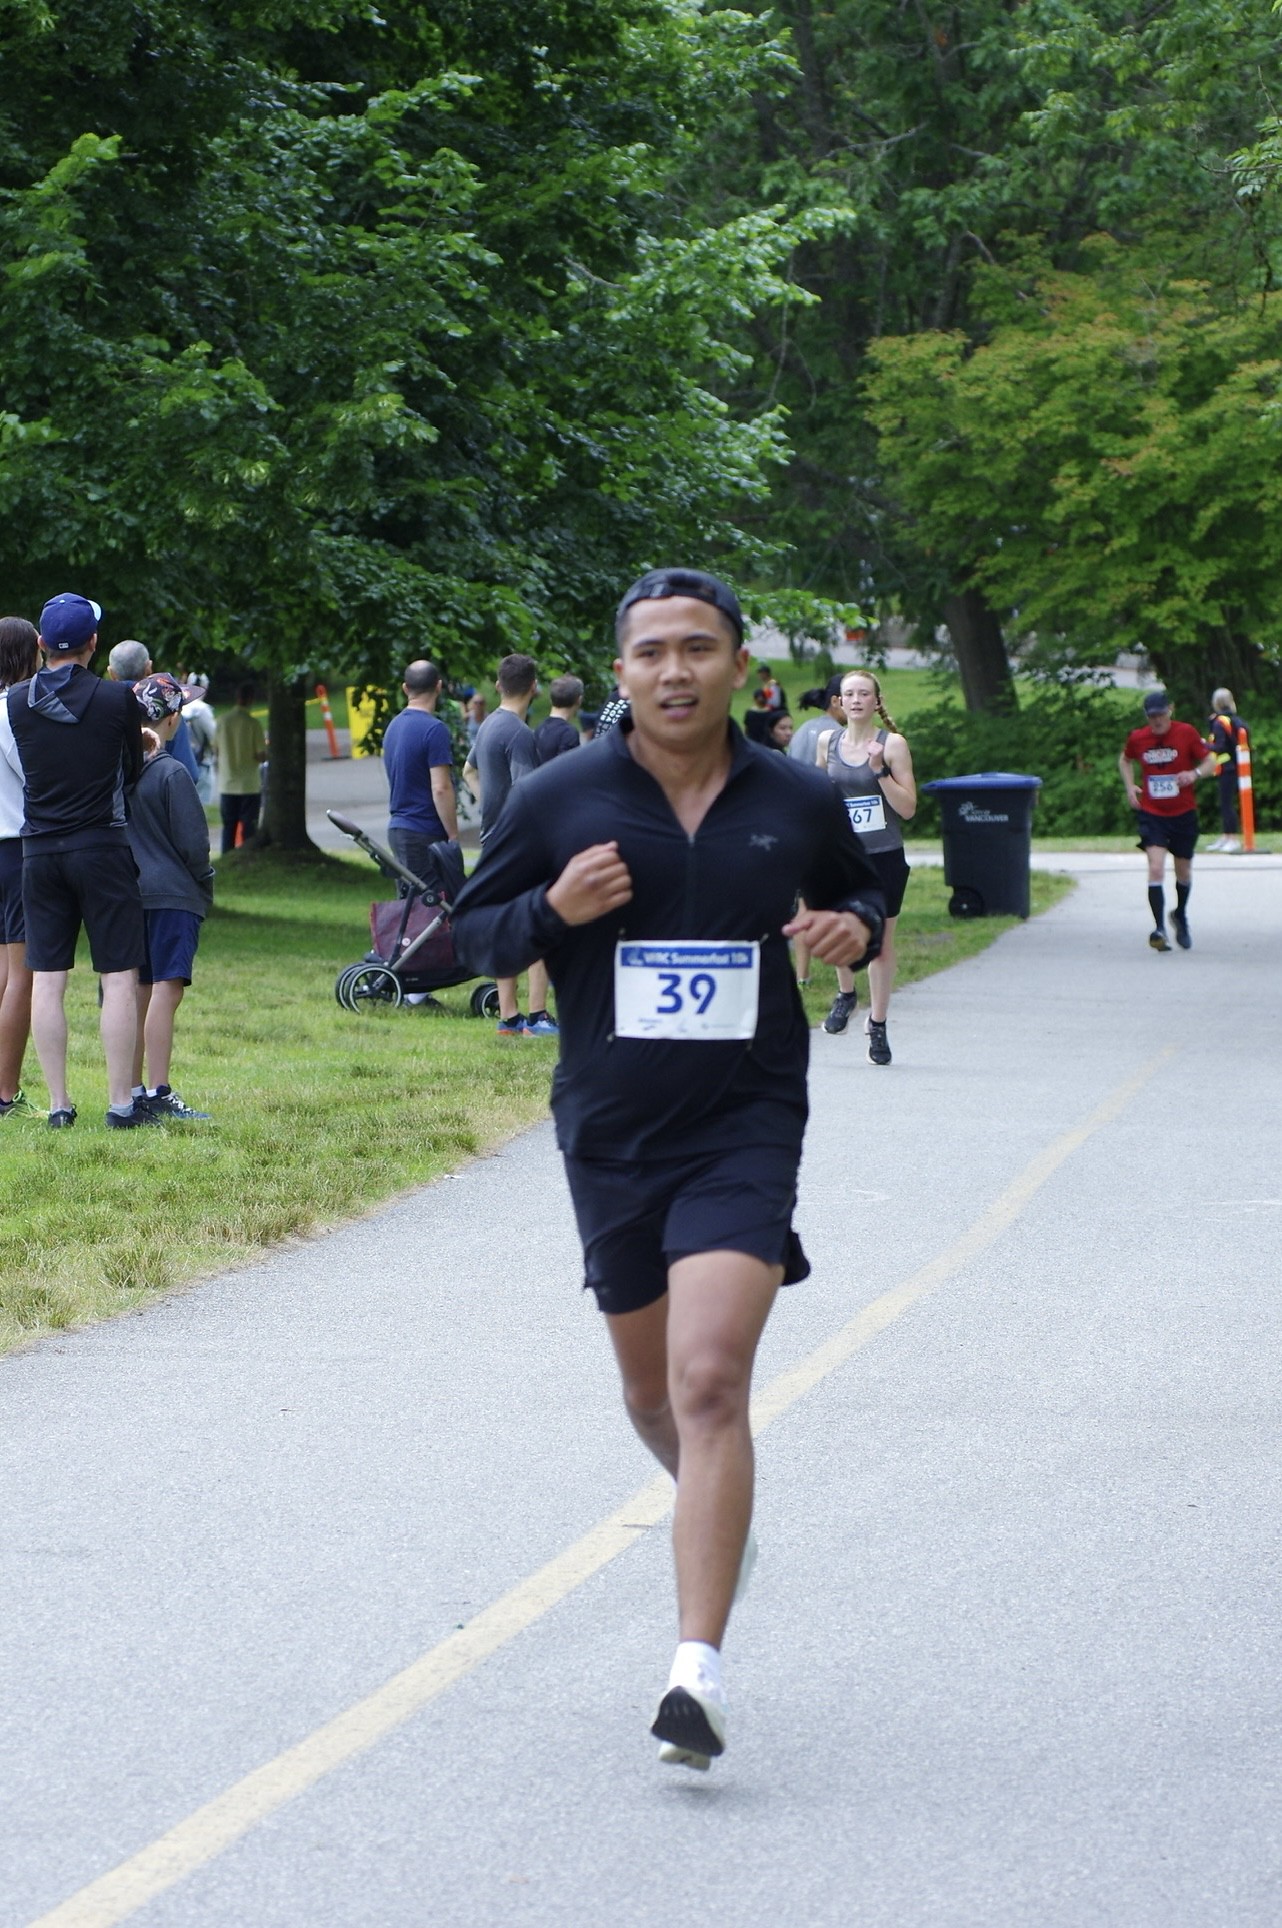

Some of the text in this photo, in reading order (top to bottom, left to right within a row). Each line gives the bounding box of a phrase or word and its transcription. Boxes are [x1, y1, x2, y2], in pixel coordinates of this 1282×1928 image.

[600, 702, 614, 721] RUN
[606, 699, 625, 722] YOUR
[965, 813, 1009, 822] VANCOUVER
[656, 973, 716, 1015] 39
